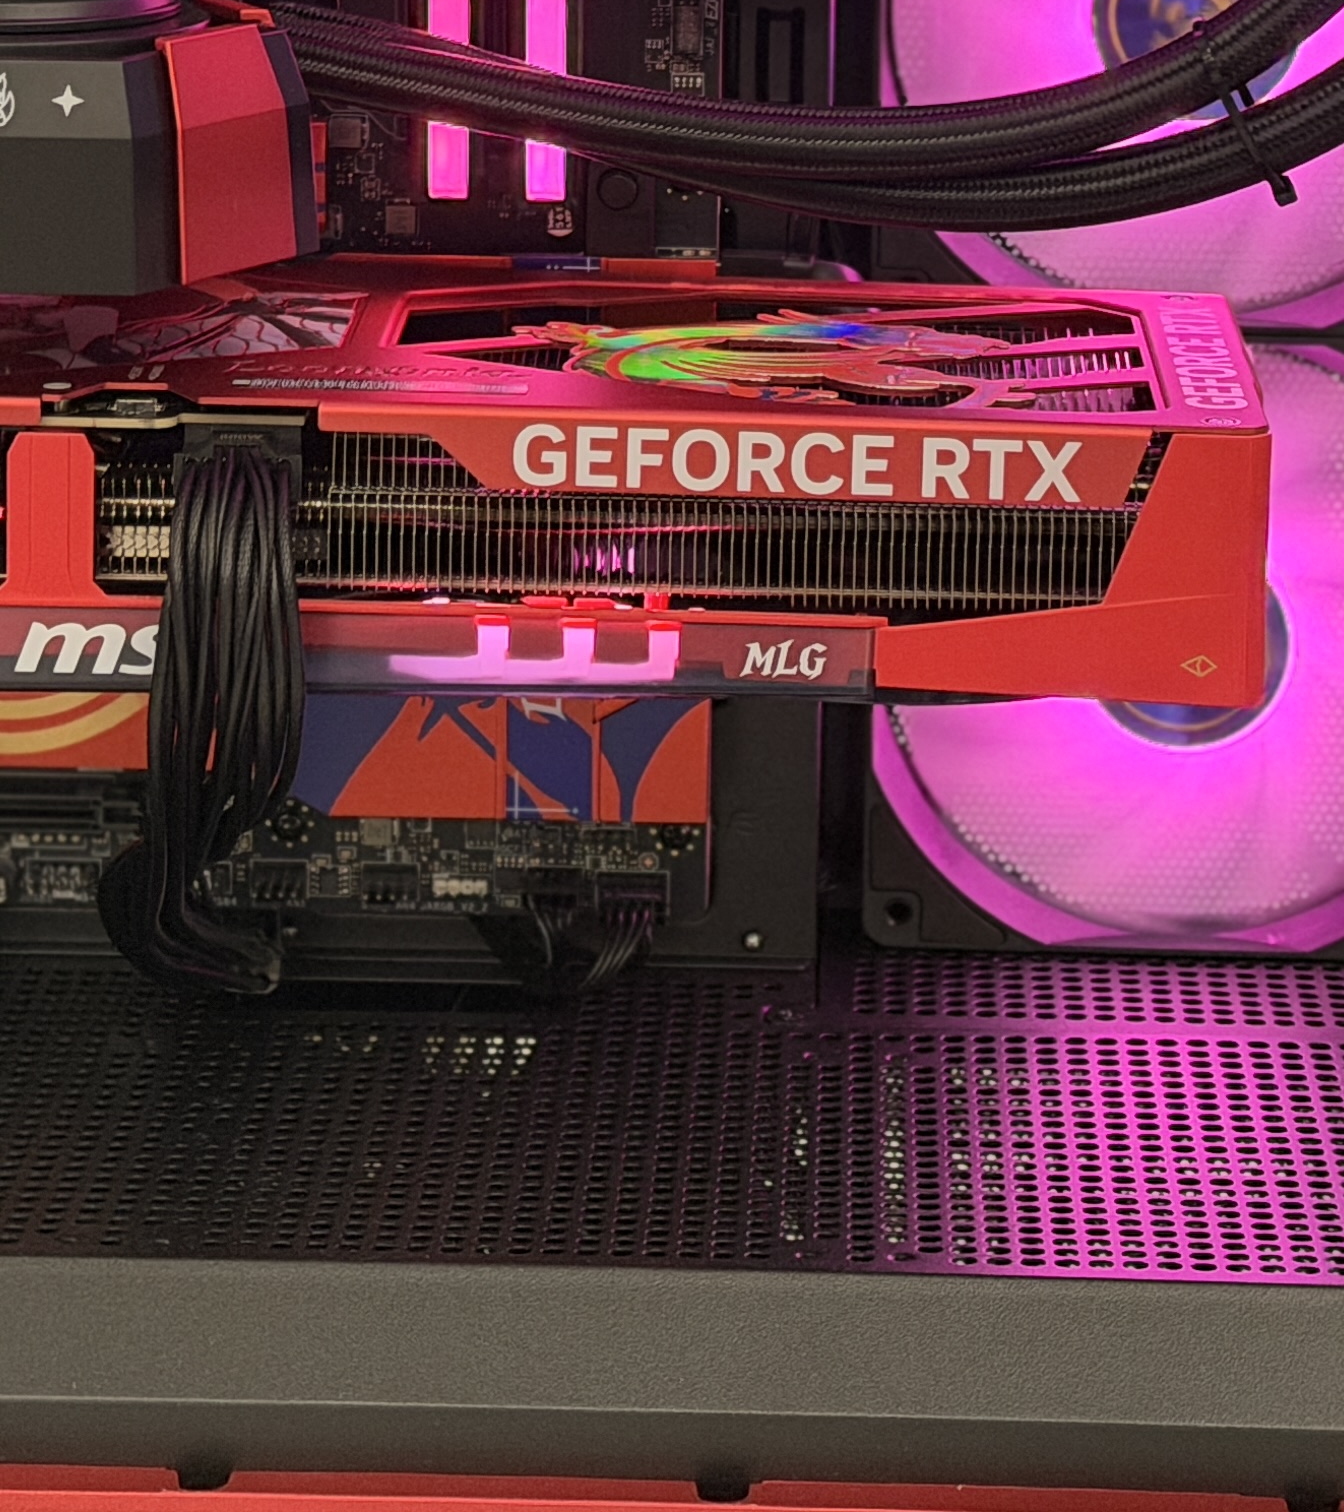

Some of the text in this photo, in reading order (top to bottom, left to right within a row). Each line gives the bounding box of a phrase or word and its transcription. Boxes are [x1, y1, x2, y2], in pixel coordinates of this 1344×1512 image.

[1158, 306, 1248, 409] GEFORCE RTX
[512, 423, 1083, 504] GEFORCE RTX
[14, 621, 158, 676] ms
[739, 639, 827, 681] MLG
